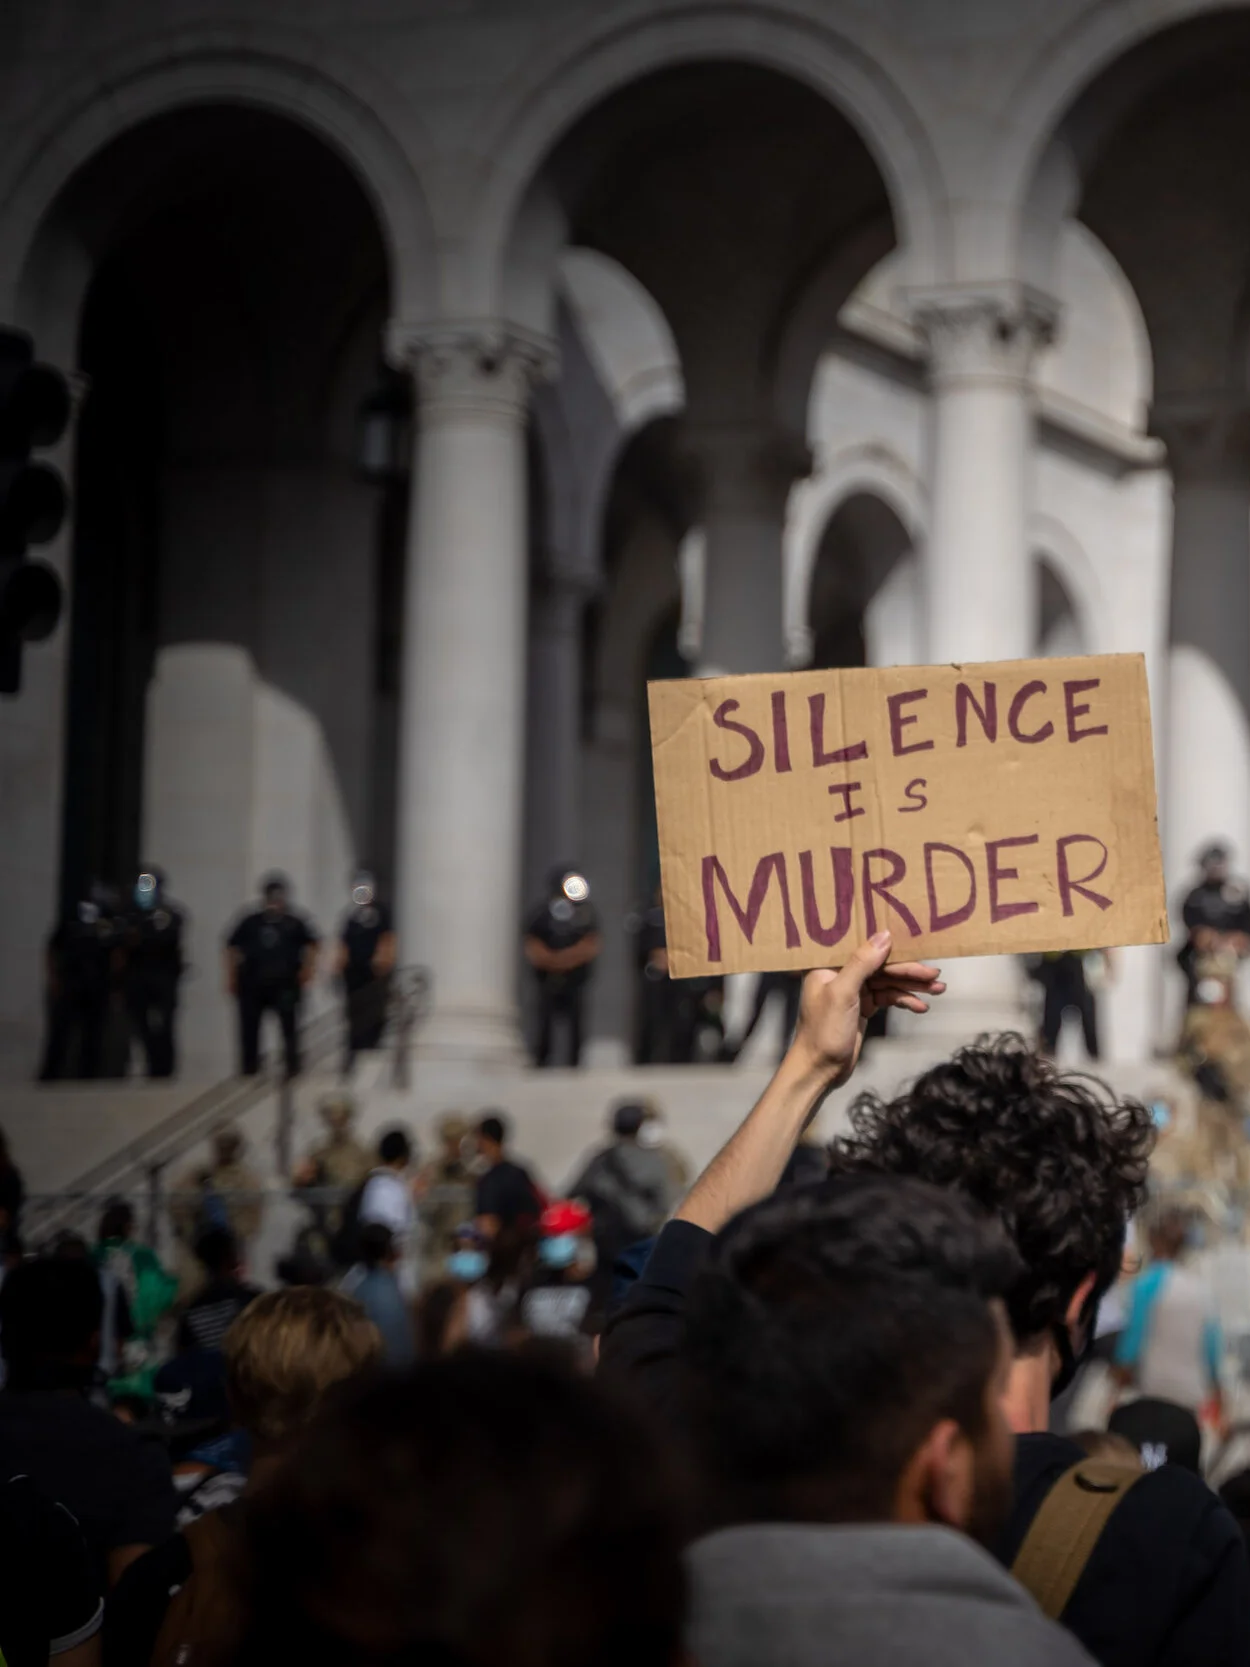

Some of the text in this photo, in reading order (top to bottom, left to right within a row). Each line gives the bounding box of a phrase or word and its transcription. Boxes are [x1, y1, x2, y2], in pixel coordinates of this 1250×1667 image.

[709, 678, 1108, 782] SILENCE
[828, 778, 927, 822] IS
[701, 833, 1113, 963] MURDER
